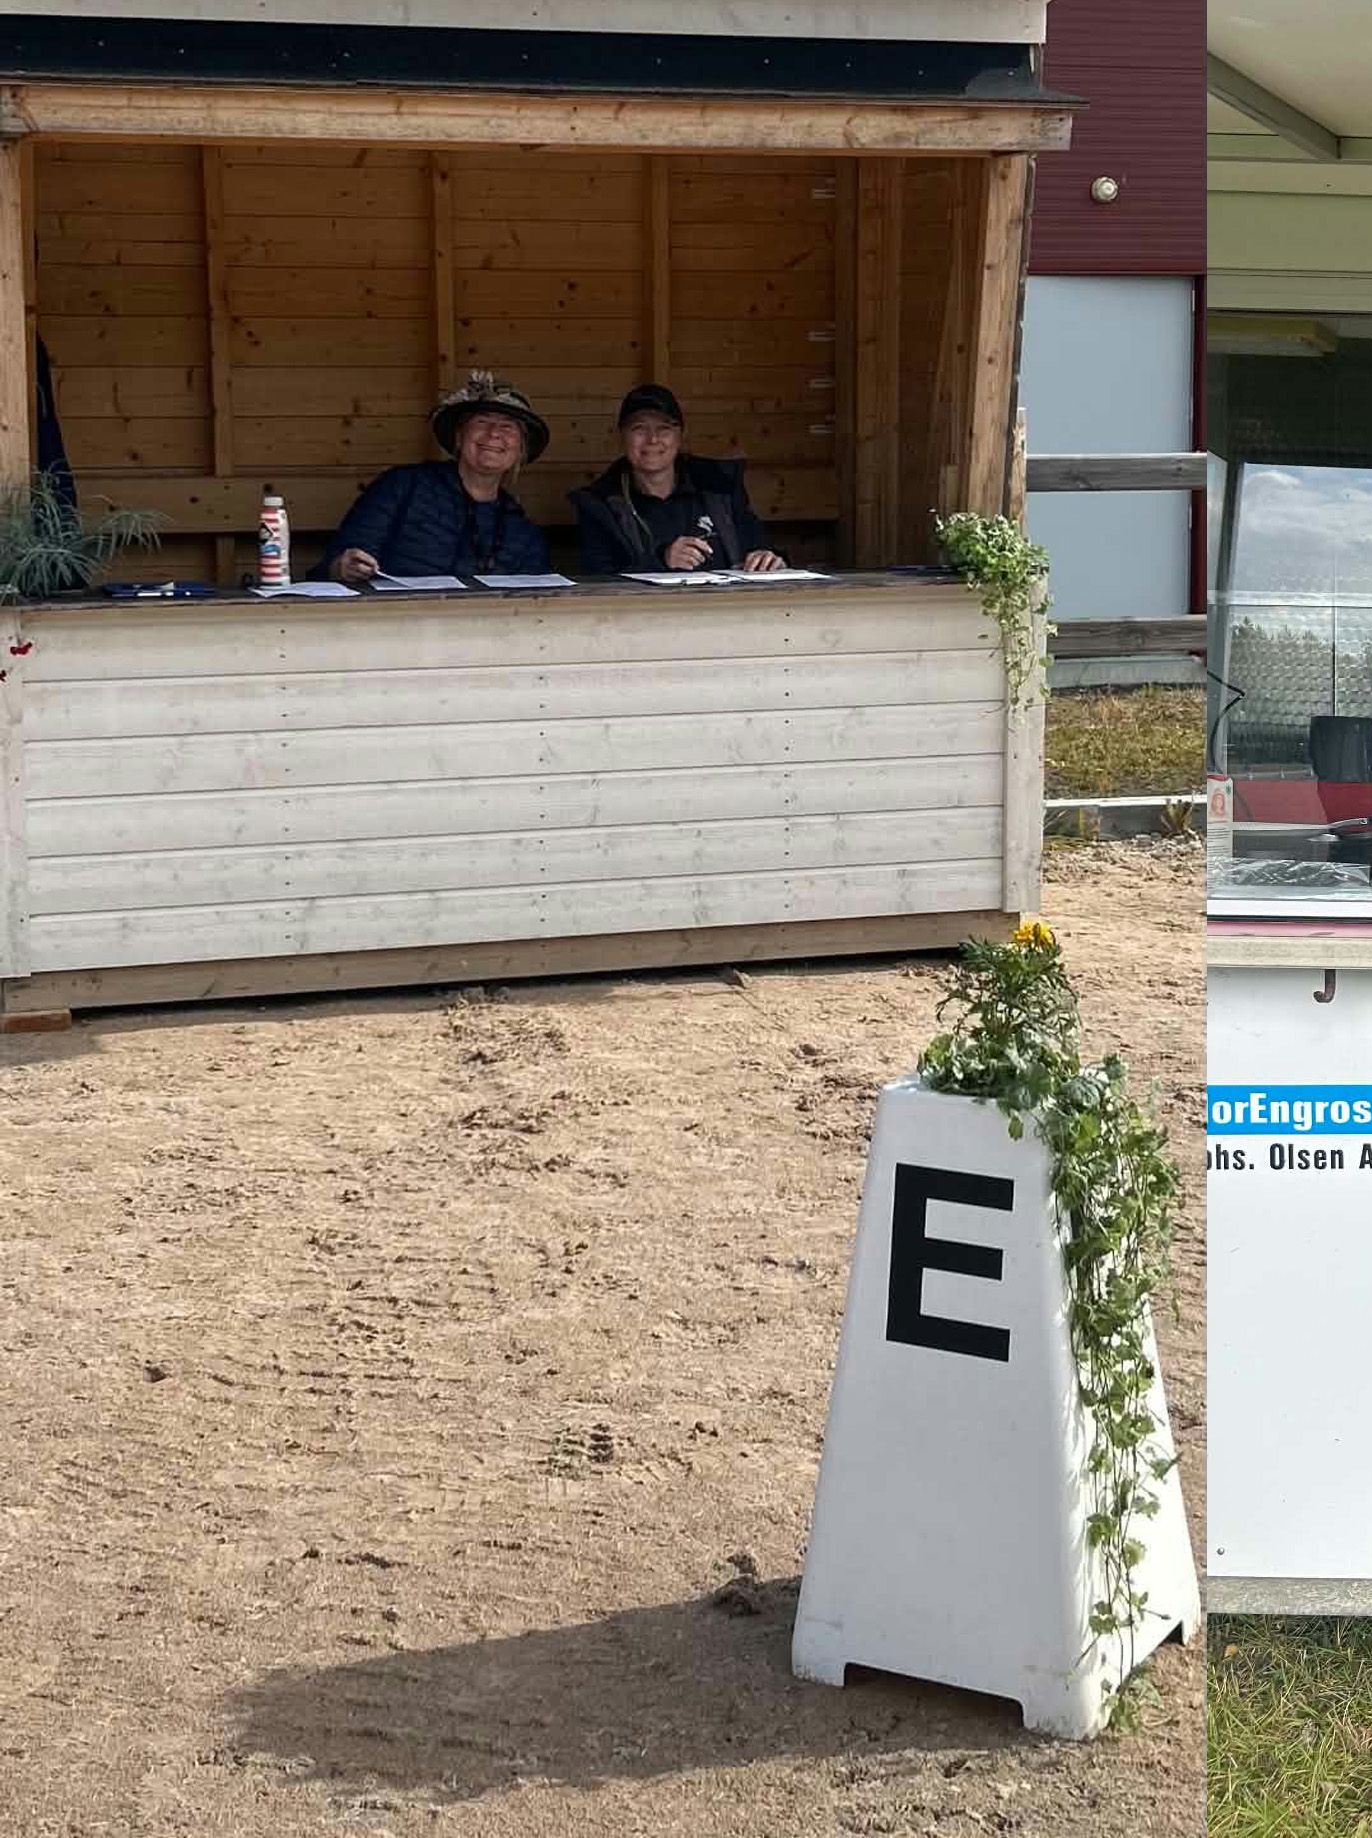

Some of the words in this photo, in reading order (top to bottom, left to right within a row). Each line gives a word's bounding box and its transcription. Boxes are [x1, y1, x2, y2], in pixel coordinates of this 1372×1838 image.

[1207, 1092, 1372, 1131] orEngros
[1268, 1143, 1345, 1170] Olsen
[886, 1162, 1015, 1362] E
